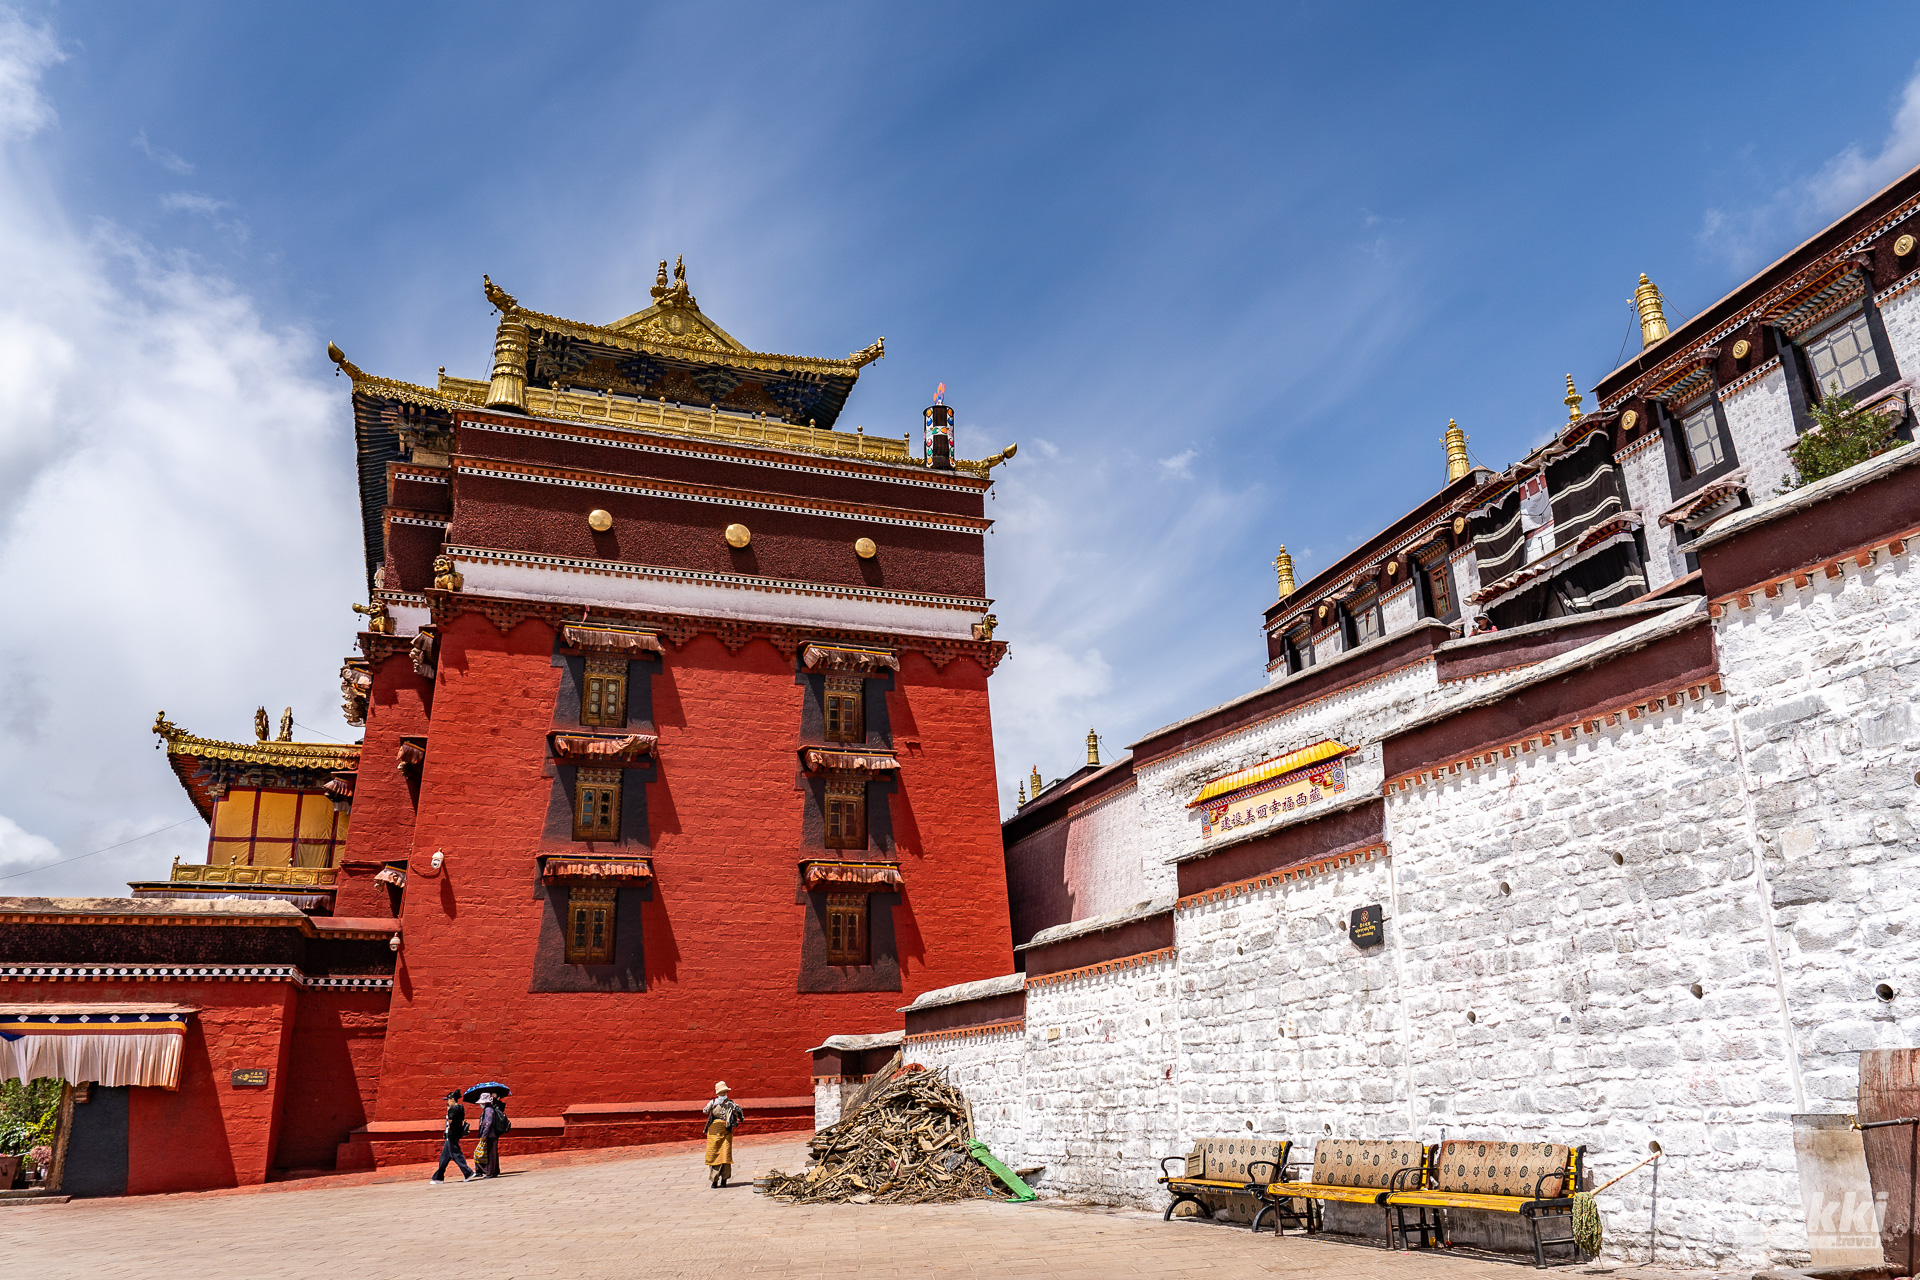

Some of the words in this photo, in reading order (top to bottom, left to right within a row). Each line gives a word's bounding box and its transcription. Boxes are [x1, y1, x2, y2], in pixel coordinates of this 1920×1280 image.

[1220, 785, 1323, 831] 建设美丽幸福西藏
